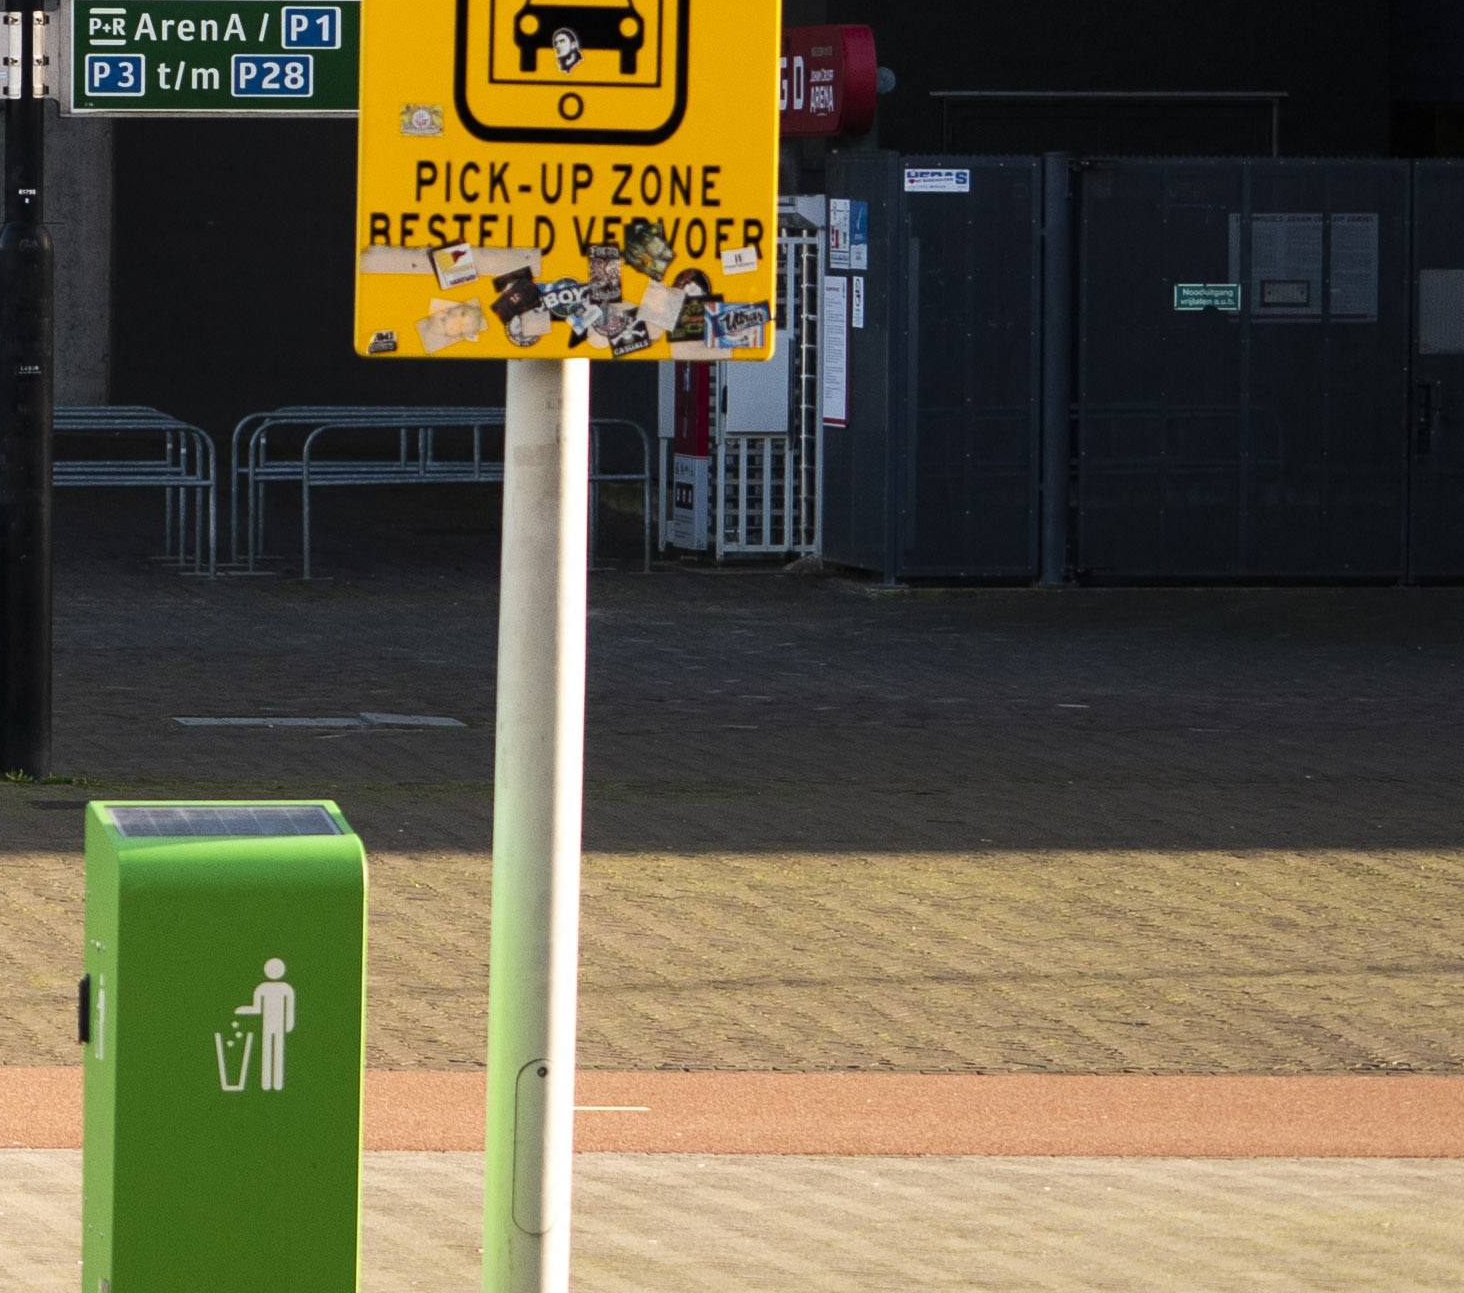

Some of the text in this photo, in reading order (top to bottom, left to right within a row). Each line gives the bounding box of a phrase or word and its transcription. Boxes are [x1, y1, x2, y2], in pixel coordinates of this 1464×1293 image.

[89, 17, 126, 36] P+R
[133, 13, 246, 41] ArenA
[290, 14, 330, 42] P1
[93, 61, 305, 91] P3 t/m P28
[793, 55, 804, 110] D
[415, 160, 722, 207] PICK-UP ZONE
[574, 216, 764, 260] VEVOER
[1182, 288, 1234, 297] Nooduitgang
[614, 340, 649, 356] CASUALS
